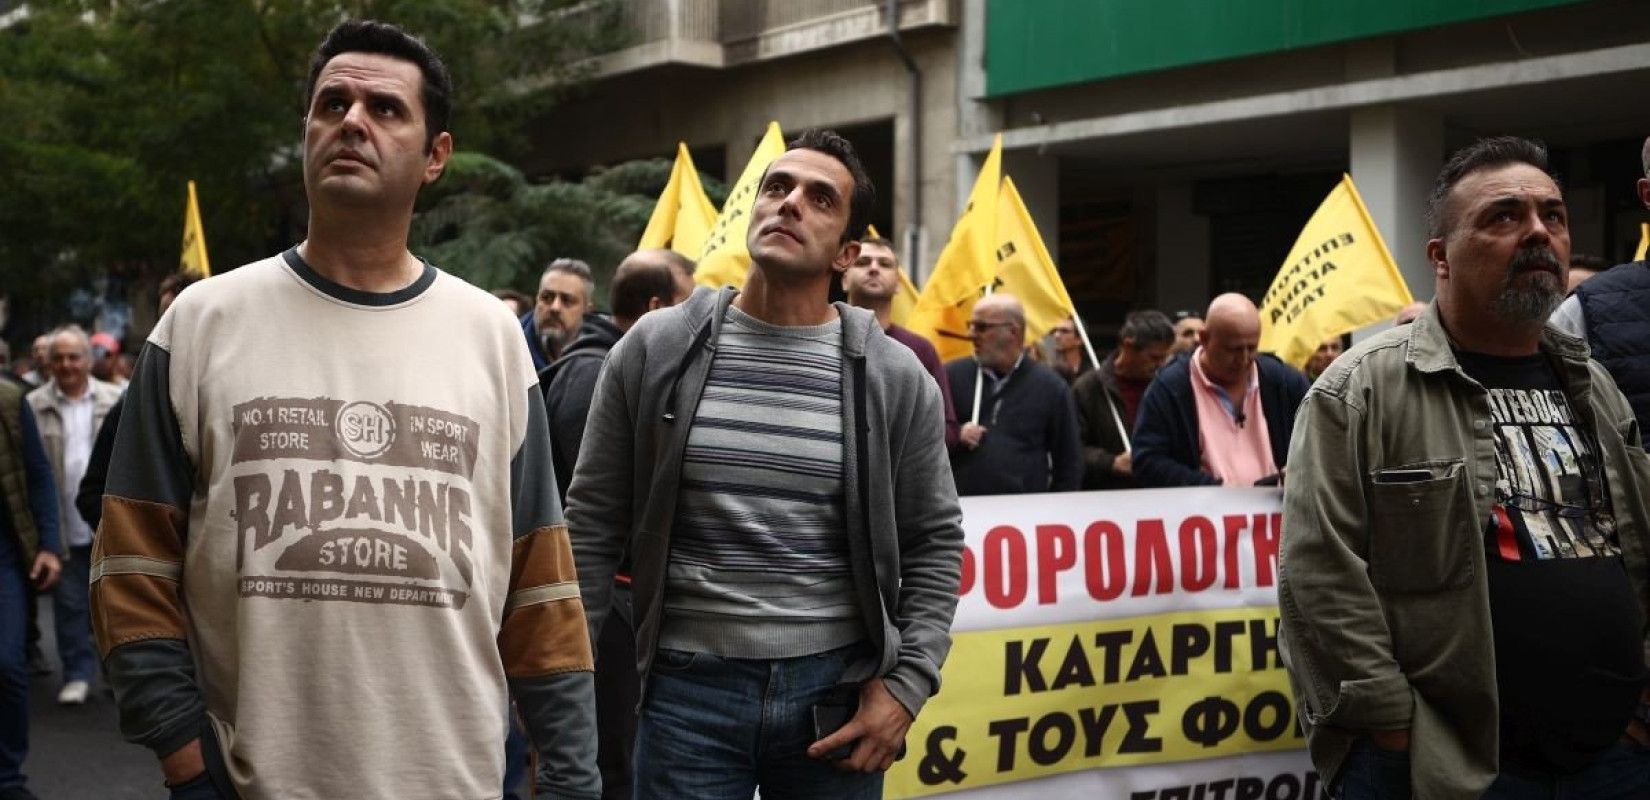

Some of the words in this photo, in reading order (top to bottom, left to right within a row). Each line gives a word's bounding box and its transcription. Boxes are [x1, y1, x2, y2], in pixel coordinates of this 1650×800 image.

[241, 409, 274, 427] NO.1
[278, 407, 329, 427] RETAIL
[344, 413, 382, 444] SH
[426, 417, 469, 442] SPORT
[259, 432, 309, 451] STORE
[420, 440, 459, 463] WEAR
[233, 469, 474, 590] RABANNE
[318, 537, 408, 570] STORE
[958, 513, 1281, 609] ΟΡΟΛΟΓΗ
[241, 580, 294, 593] SPORT'S
[302, 582, 347, 596] HOUSE
[354, 586, 384, 599] NEW
[1003, 617, 1286, 697] ΚΑΤΑΡΓΗ
[917, 725, 969, 786] &
[988, 699, 1163, 774] ΤΟΥΣ
[1181, 690, 1303, 748] ΦΟ
[1129, 772, 1320, 800] ΙΤΡΟ
